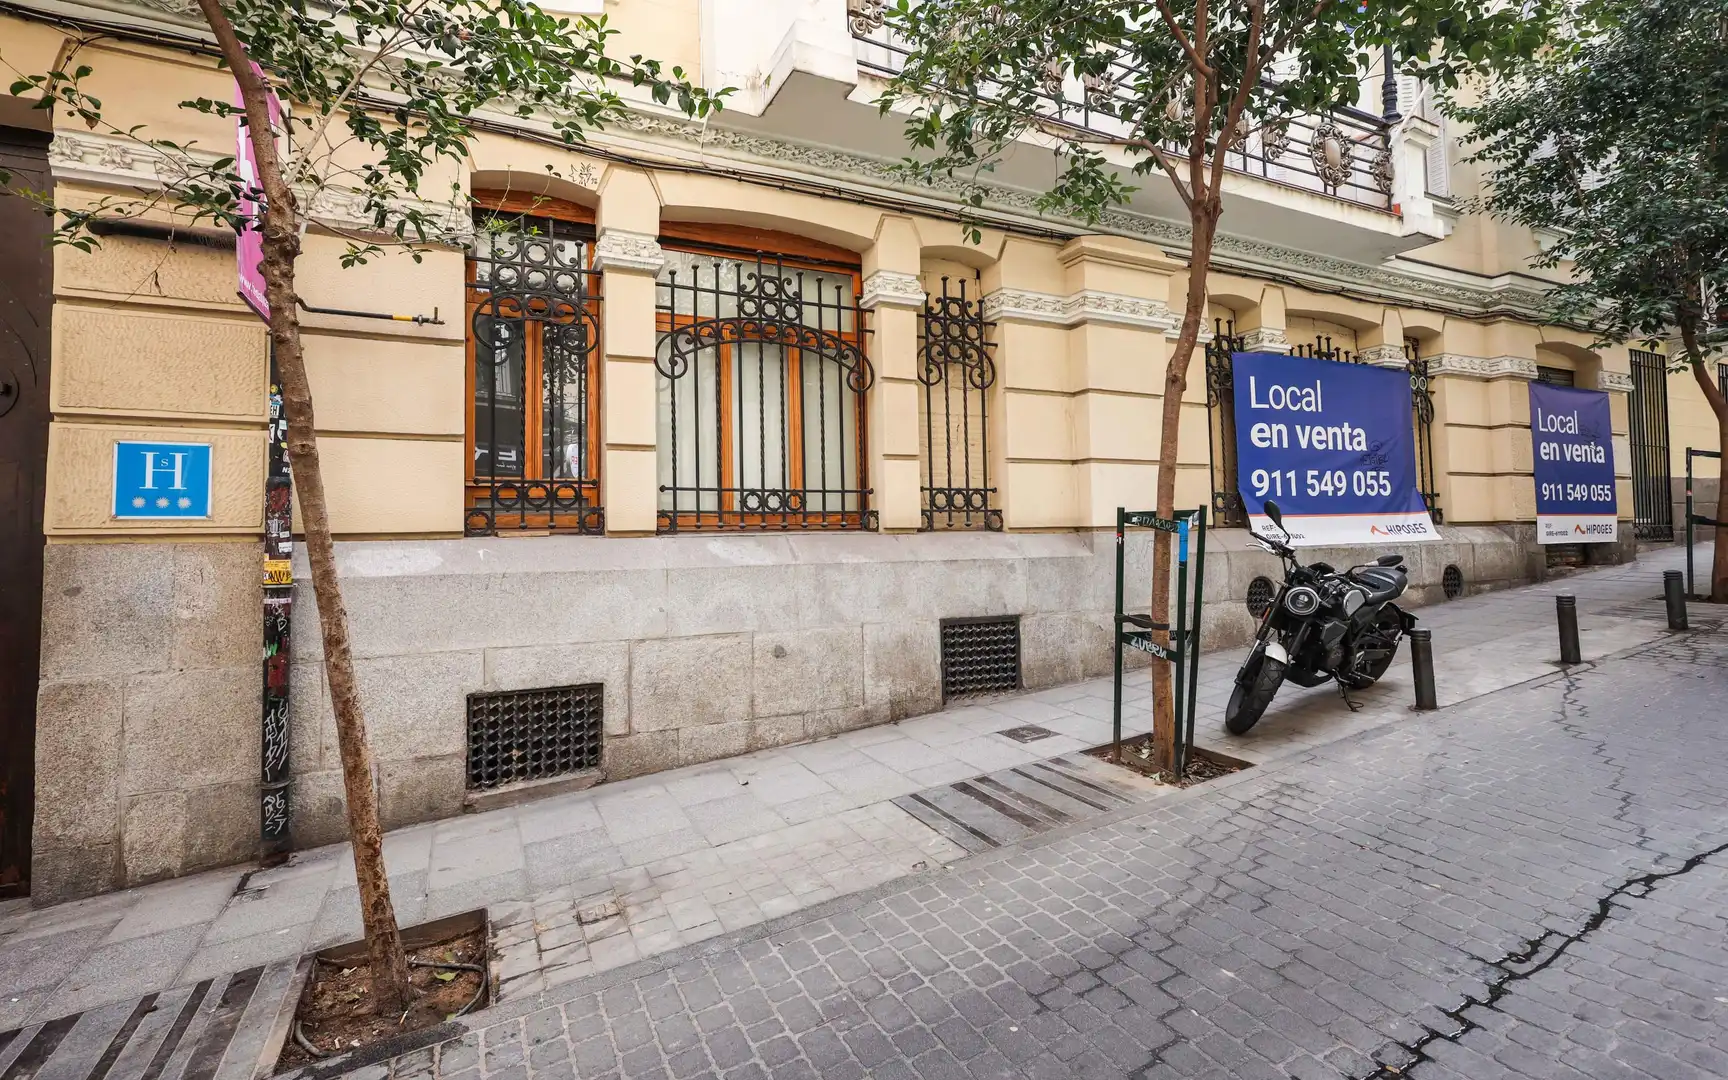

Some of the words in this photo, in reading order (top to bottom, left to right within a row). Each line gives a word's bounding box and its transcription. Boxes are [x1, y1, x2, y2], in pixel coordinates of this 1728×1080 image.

[1250, 376, 1322, 412] Local
[1538, 407, 1579, 435] Local
[1250, 421, 1289, 449] en
[1295, 421, 1368, 452] venta
[1540, 441, 1560, 461] en
[1563, 442, 1605, 464] venta
[1251, 469, 1297, 497] 911
[1306, 469, 1347, 497] 549
[1353, 471, 1392, 497] 055
[1542, 483, 1563, 501] 911
[1567, 483, 1588, 502] 549
[1590, 485, 1612, 502] 055
[1386, 523, 1427, 536] HIPOGES
[1586, 524, 1613, 535] HIPOGES
